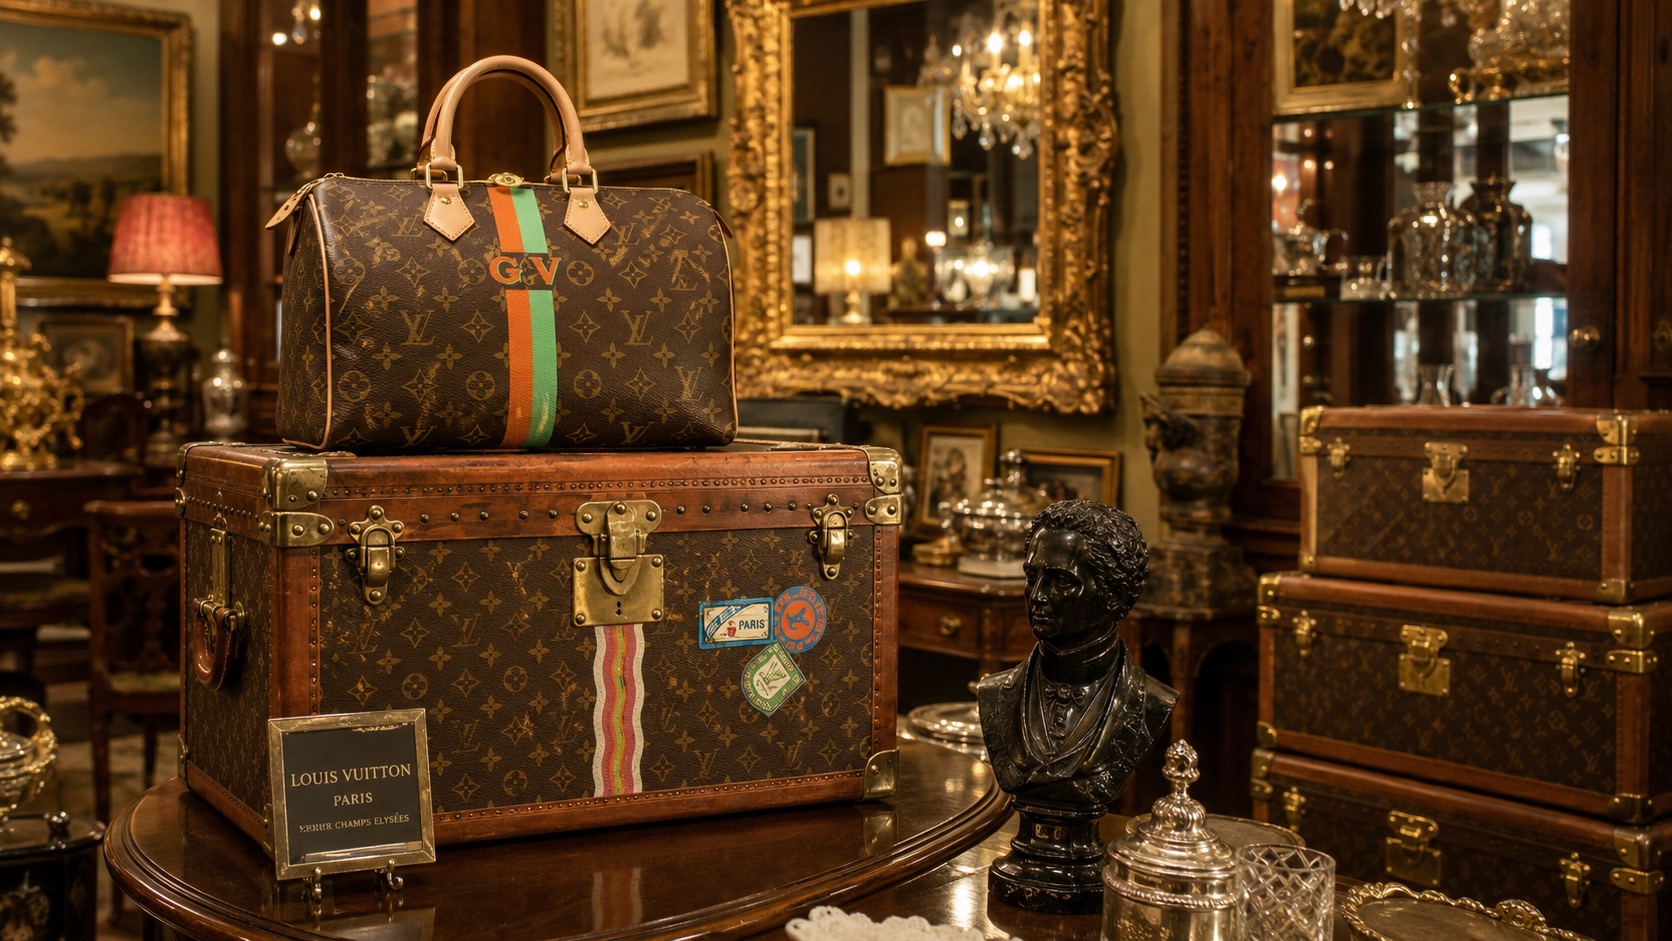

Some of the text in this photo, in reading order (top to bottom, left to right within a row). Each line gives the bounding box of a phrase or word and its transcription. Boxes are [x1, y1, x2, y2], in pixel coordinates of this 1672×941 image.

[400, 310, 435, 346] LV
[620, 310, 654, 346] LV
[739, 619, 765, 631] PARIS
[291, 763, 412, 787] LOUIS VUITTON
[333, 792, 373, 806] PARIS
[335, 818, 371, 829] CHAMPS
